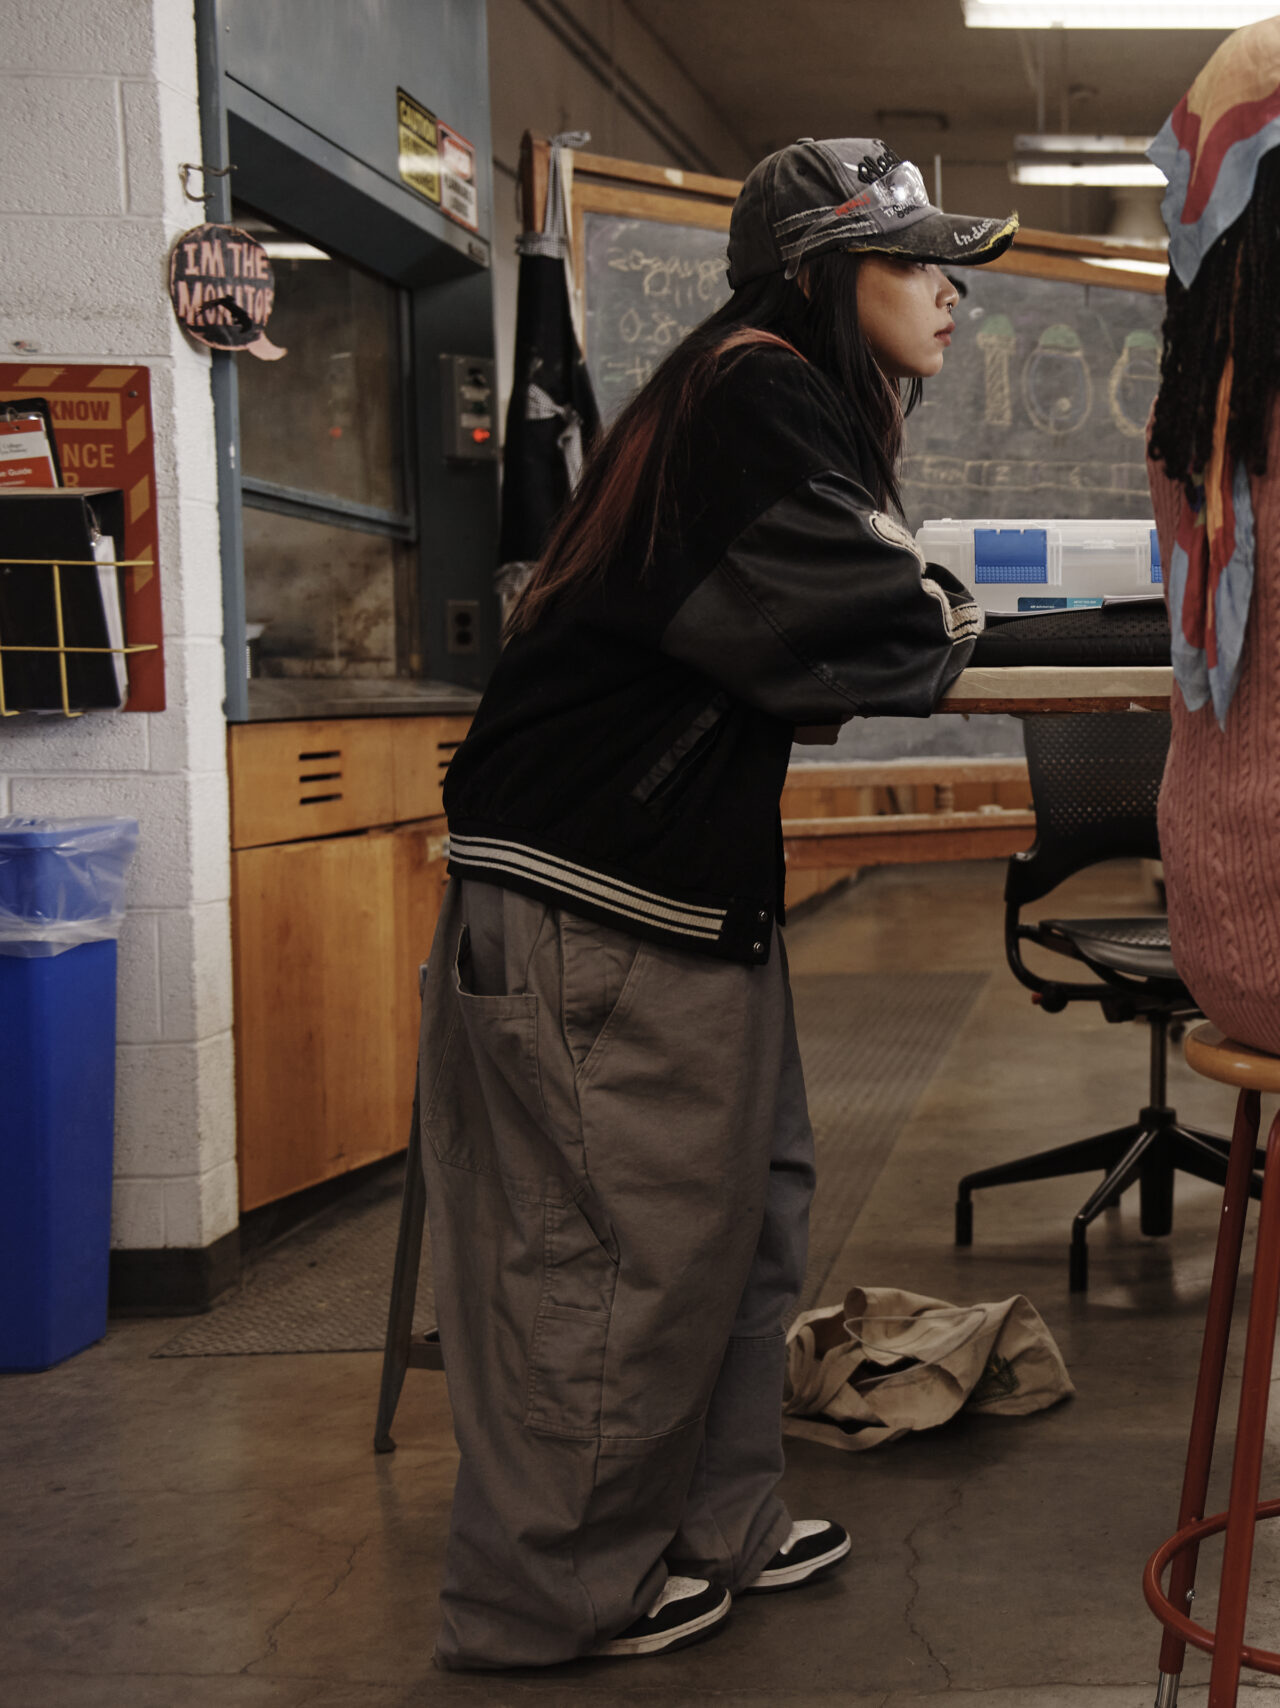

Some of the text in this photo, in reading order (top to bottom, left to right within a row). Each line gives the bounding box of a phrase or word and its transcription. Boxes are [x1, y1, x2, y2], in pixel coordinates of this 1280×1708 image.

[227, 242, 269, 279] THE
[178, 281, 274, 327] MONITOR
[50, 400, 110, 421] KNOW
